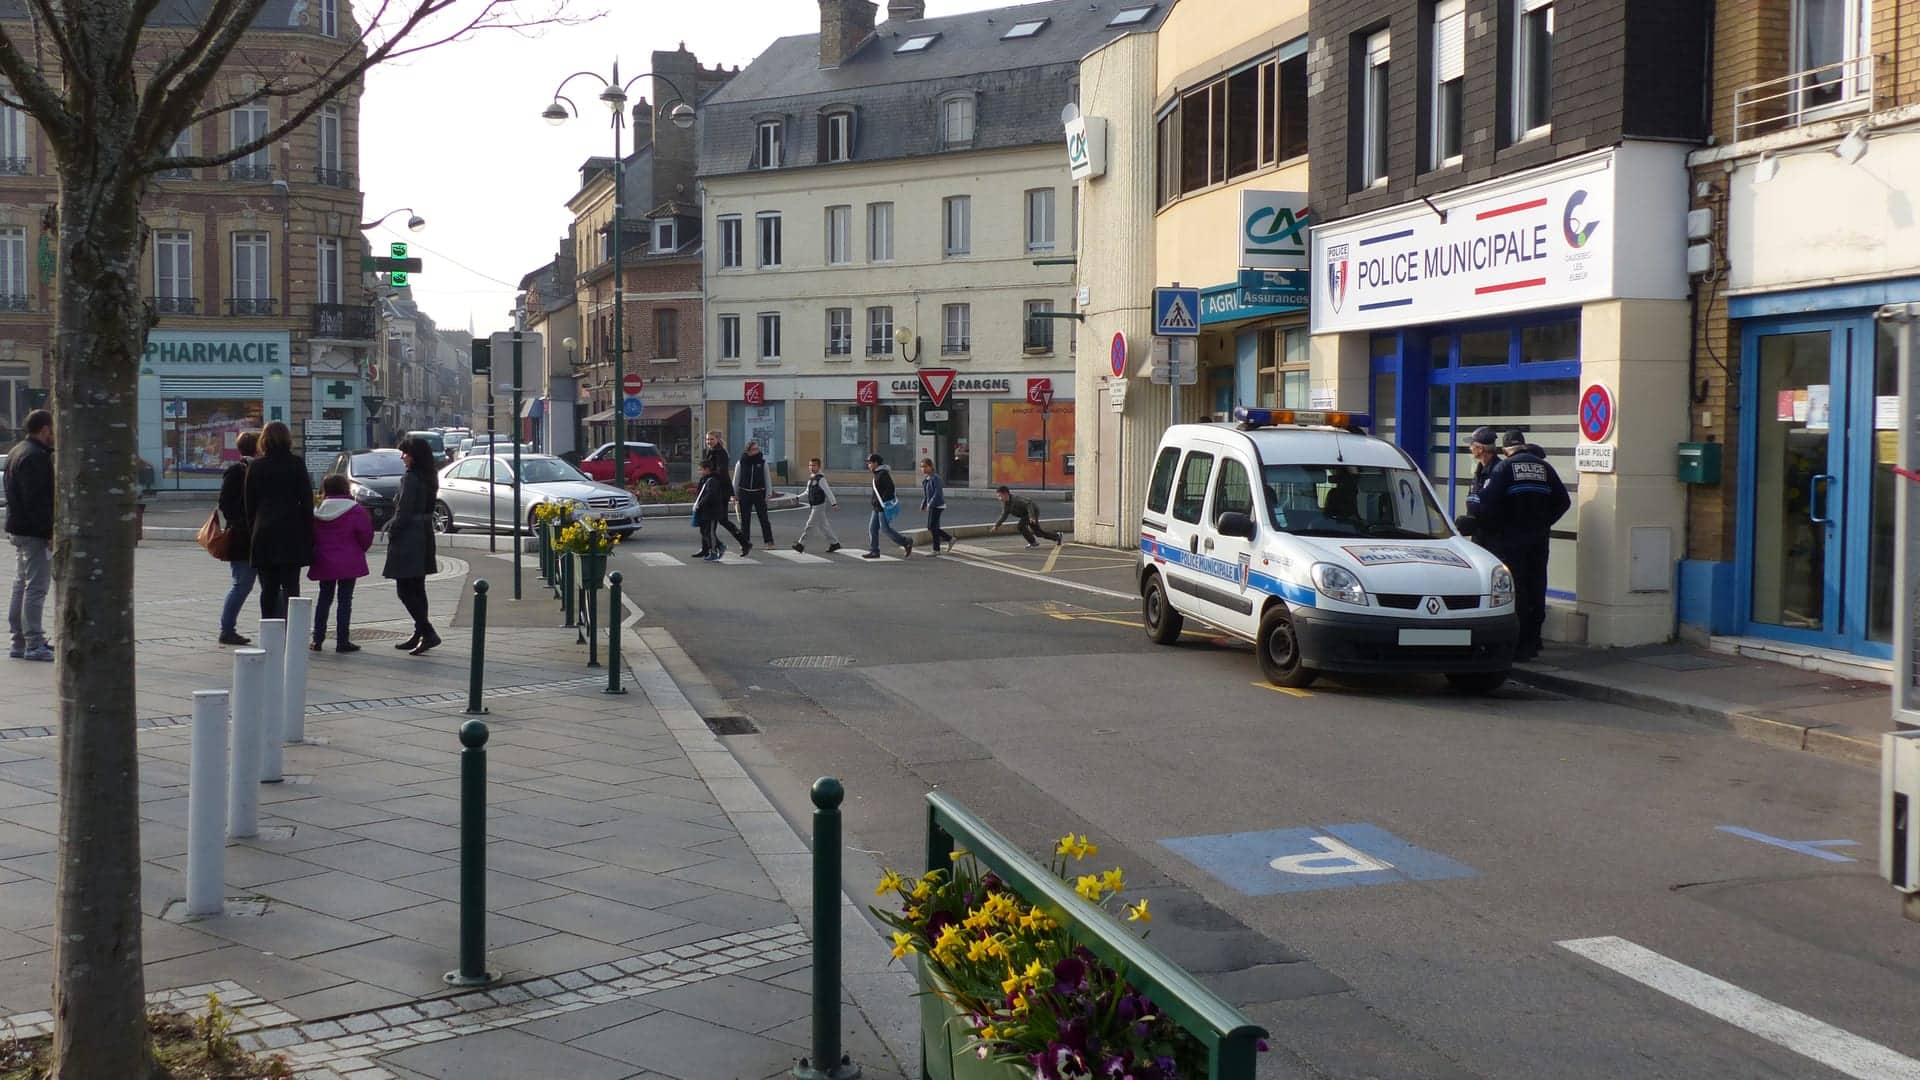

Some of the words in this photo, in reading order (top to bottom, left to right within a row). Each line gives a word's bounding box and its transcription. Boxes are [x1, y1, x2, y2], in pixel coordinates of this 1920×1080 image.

[1358, 251, 1419, 290] POLICE
[1424, 224, 1548, 279] MUNICIPALE
[1209, 293, 1246, 314] AGRI
[1243, 291, 1309, 305] Assurances
[144, 342, 280, 363] PHARMACIE
[891, 380, 919, 391] CAIS
[951, 378, 1009, 390] EPARGNE
[1592, 448, 1611, 457] POLICE
[1514, 463, 1545, 473] POLICE
[1180, 551, 1200, 570] POLICE
[1200, 556, 1233, 579] MUNICIPALE
